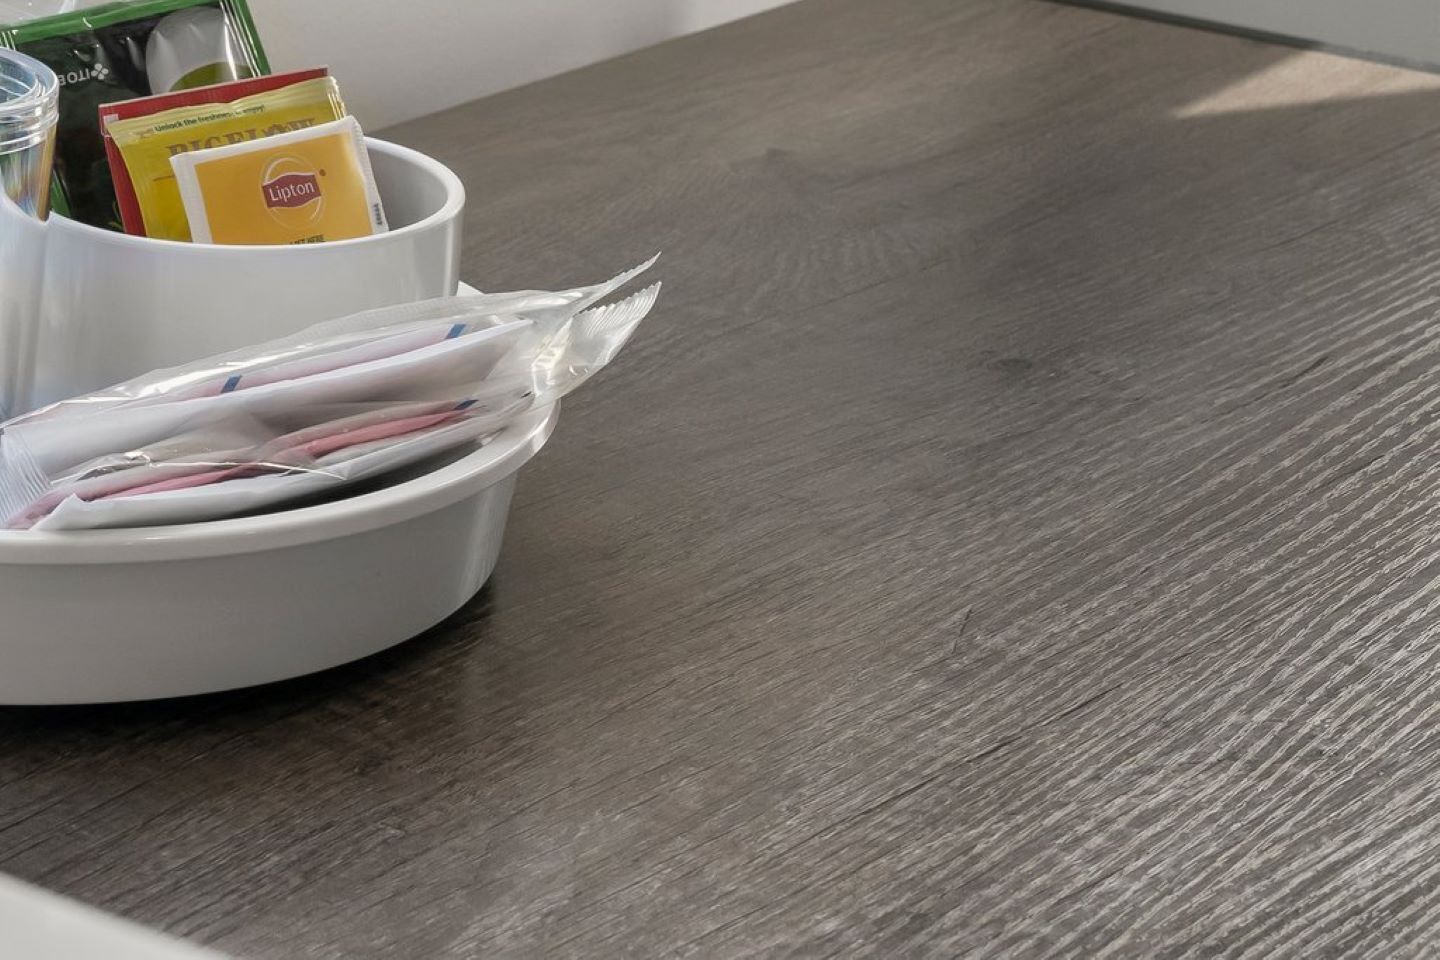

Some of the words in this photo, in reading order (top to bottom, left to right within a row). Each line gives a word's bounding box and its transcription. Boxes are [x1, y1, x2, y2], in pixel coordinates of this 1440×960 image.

[154, 118, 182, 133] Unlock
[183, 117, 198, 128] the
[269, 181, 315, 202] Lipton
